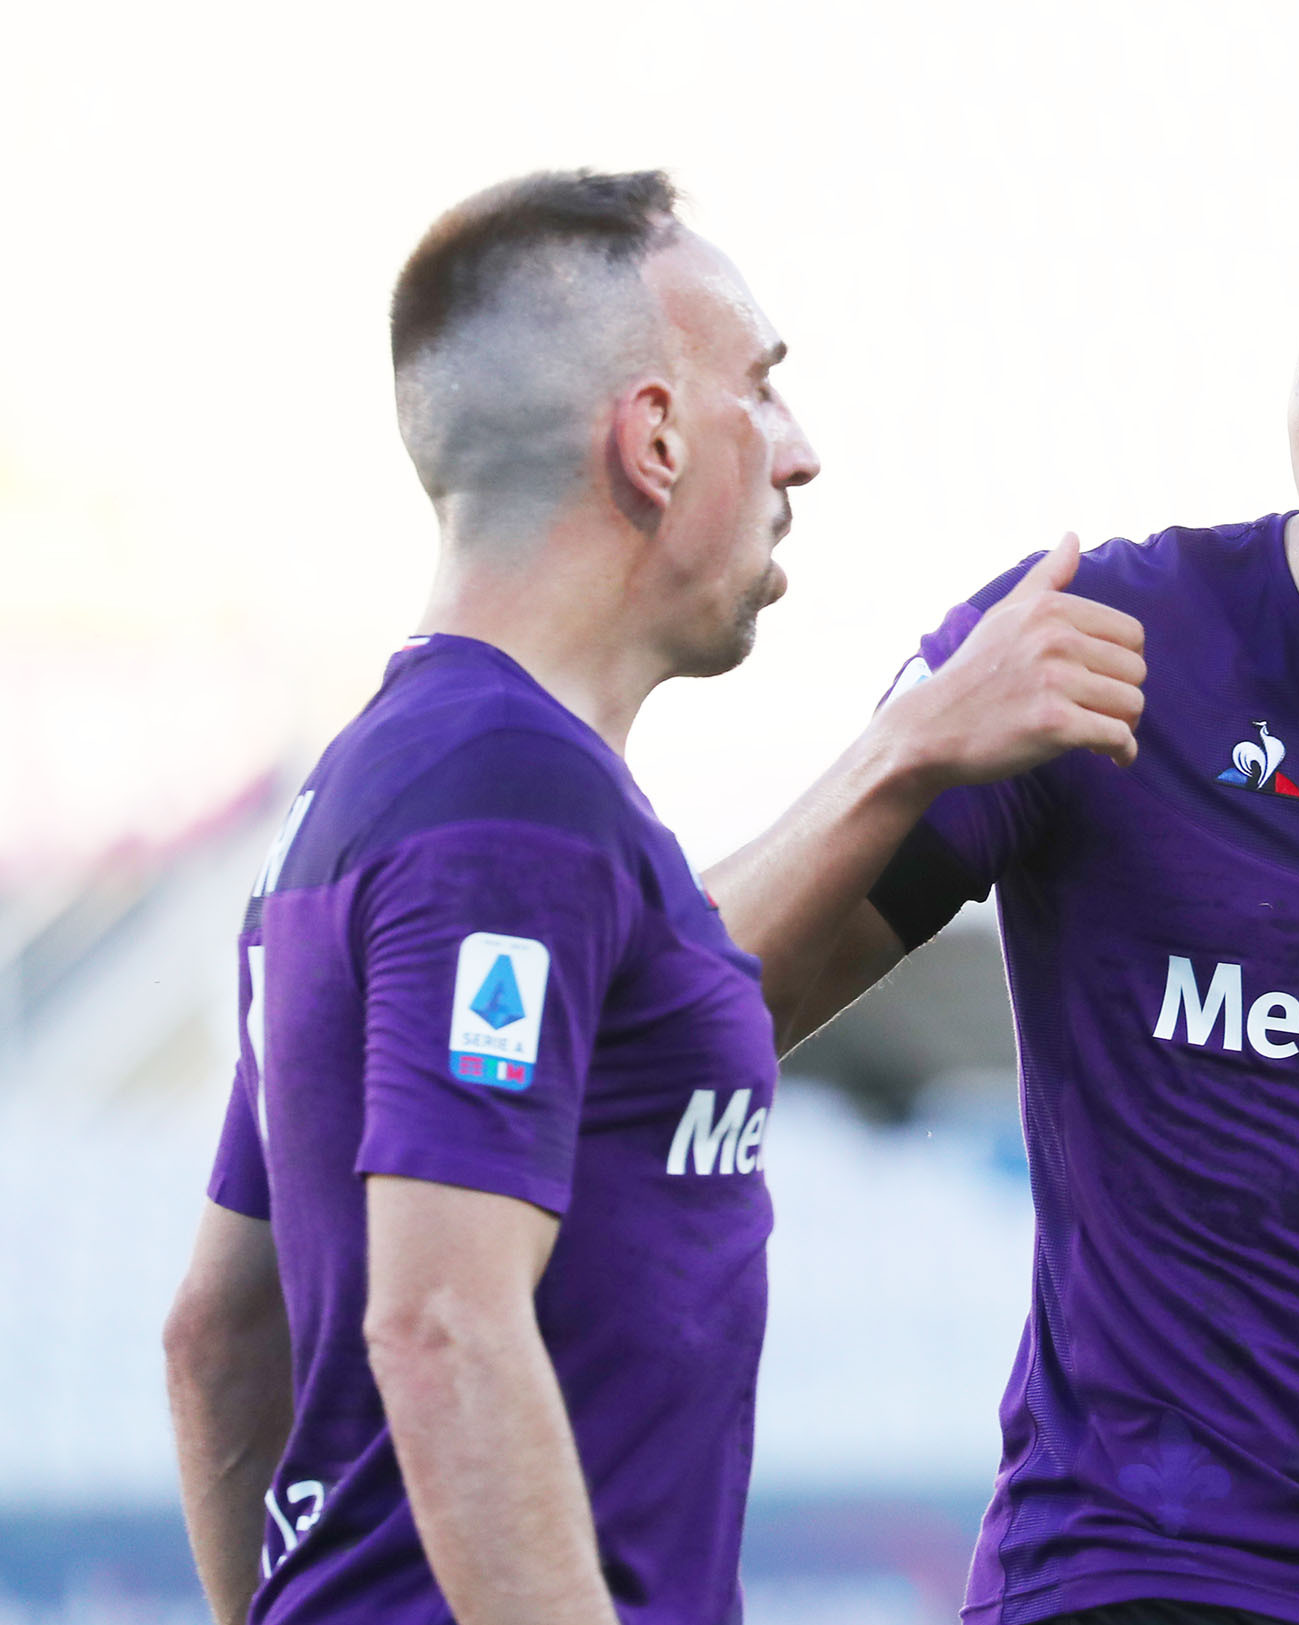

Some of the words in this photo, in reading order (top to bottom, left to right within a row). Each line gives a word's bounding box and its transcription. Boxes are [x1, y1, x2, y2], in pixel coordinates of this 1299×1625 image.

[462, 1032, 508, 1050] SERIE
[514, 1041, 523, 1053] A
[666, 1088, 767, 1175] Me
